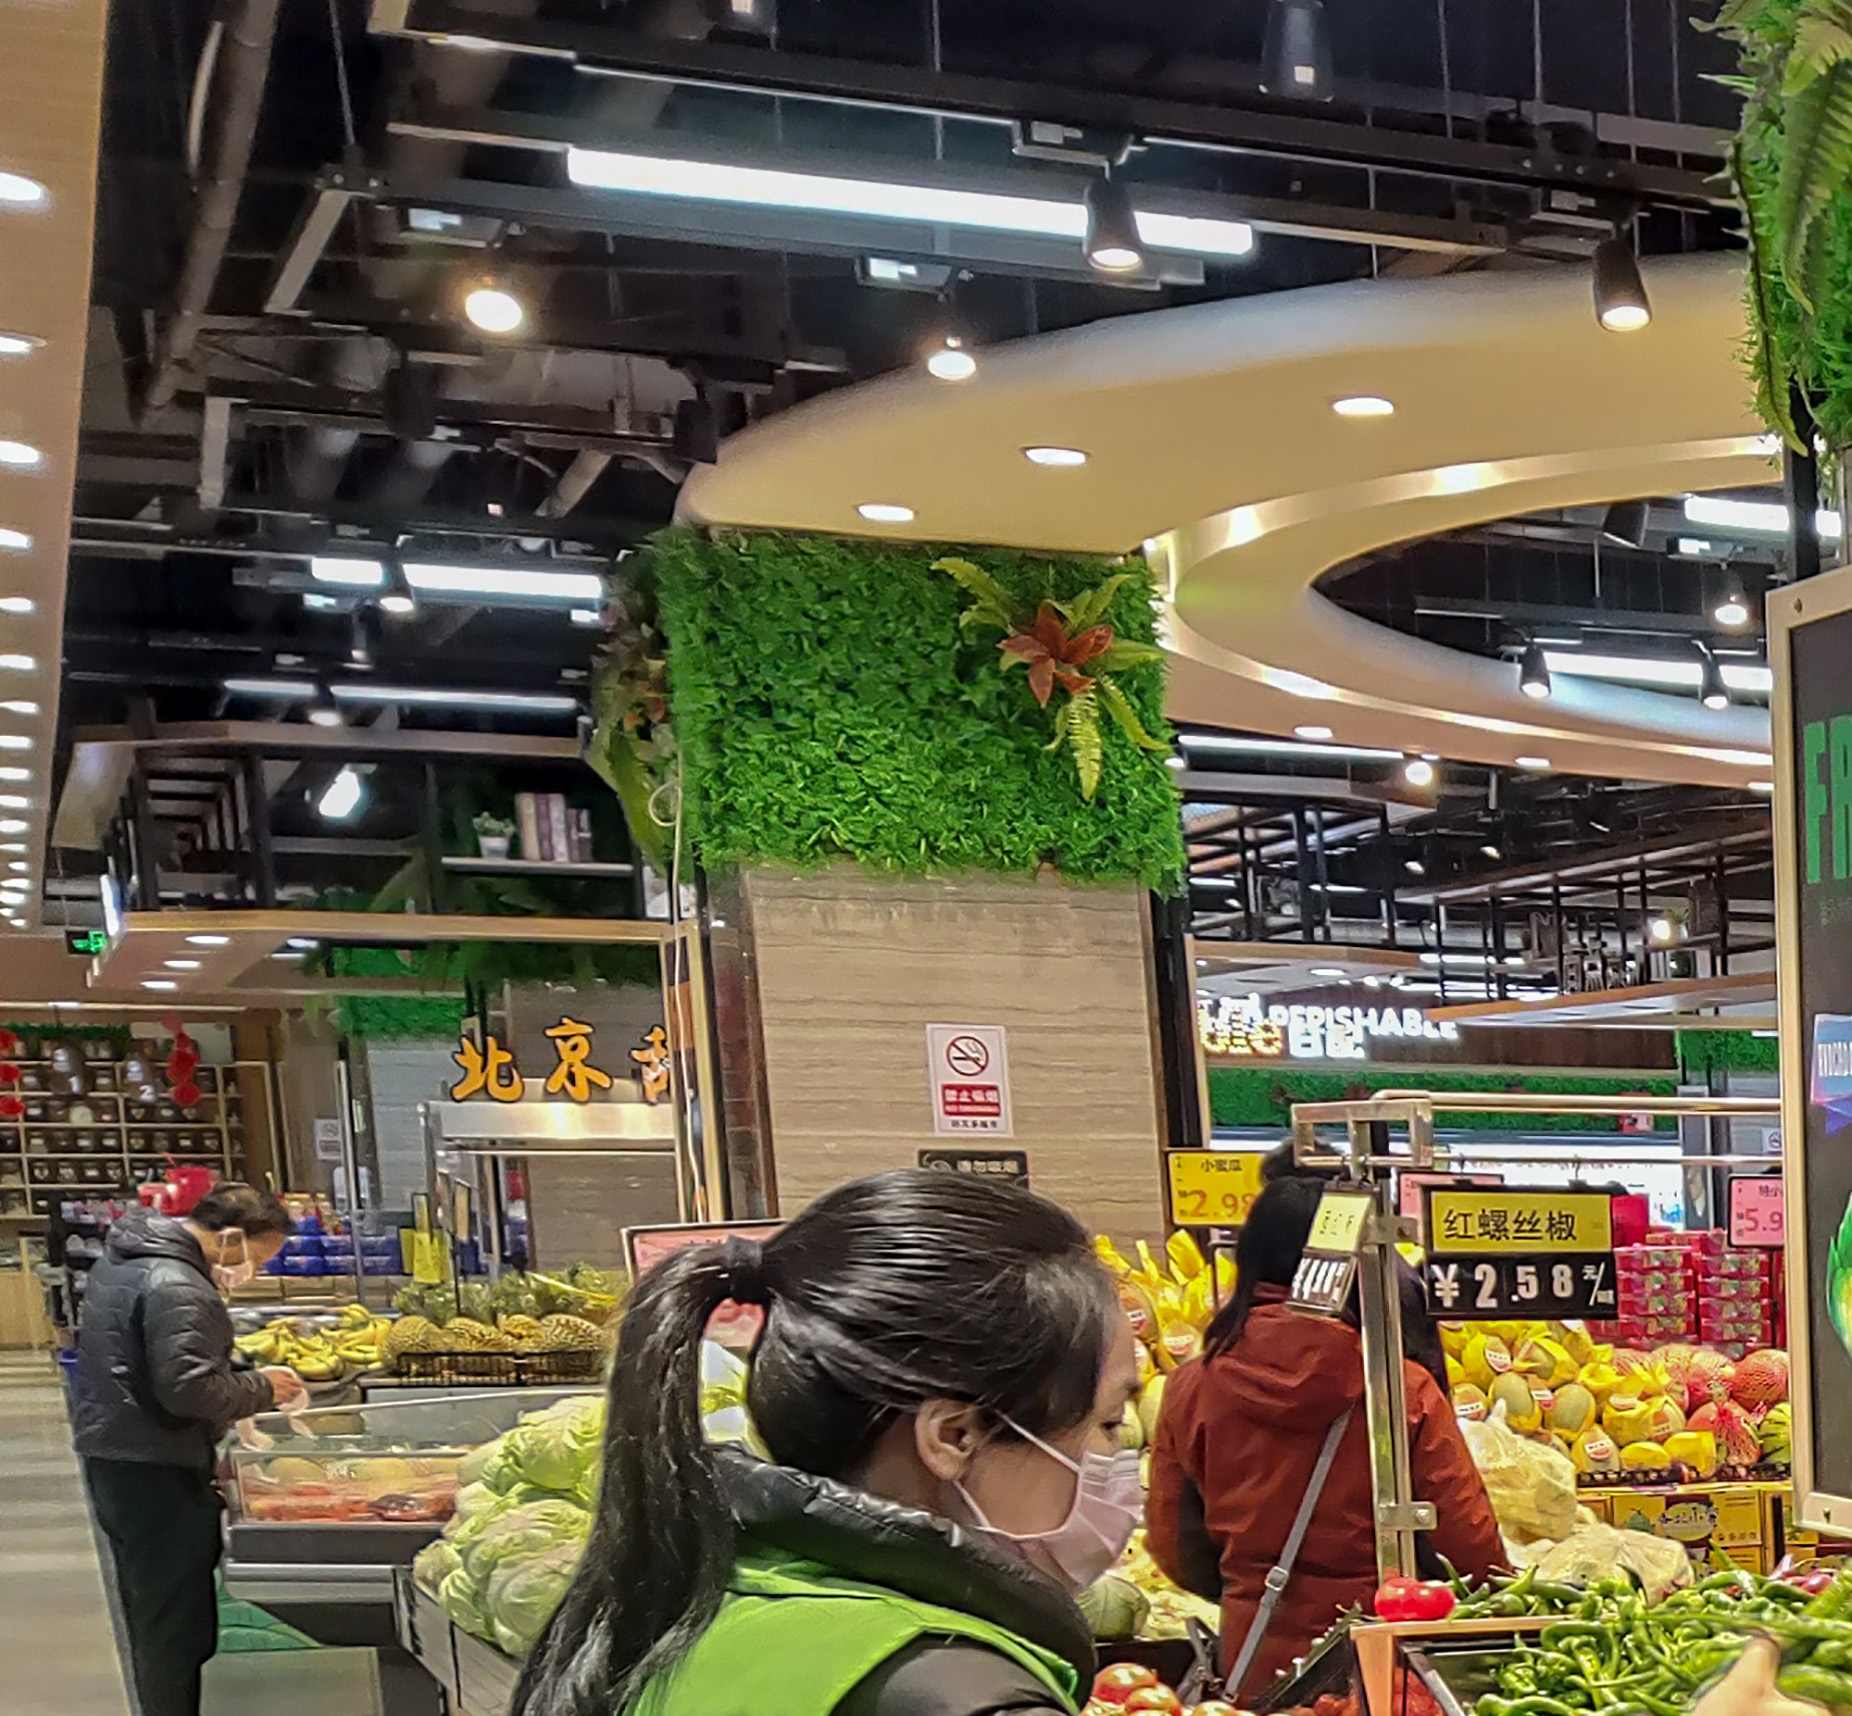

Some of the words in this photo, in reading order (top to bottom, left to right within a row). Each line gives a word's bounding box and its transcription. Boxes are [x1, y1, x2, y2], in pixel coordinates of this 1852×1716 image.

[1443, 1208, 1577, 1242] 红螺丝椒
[1432, 1264, 1574, 1308] ¥2.58
